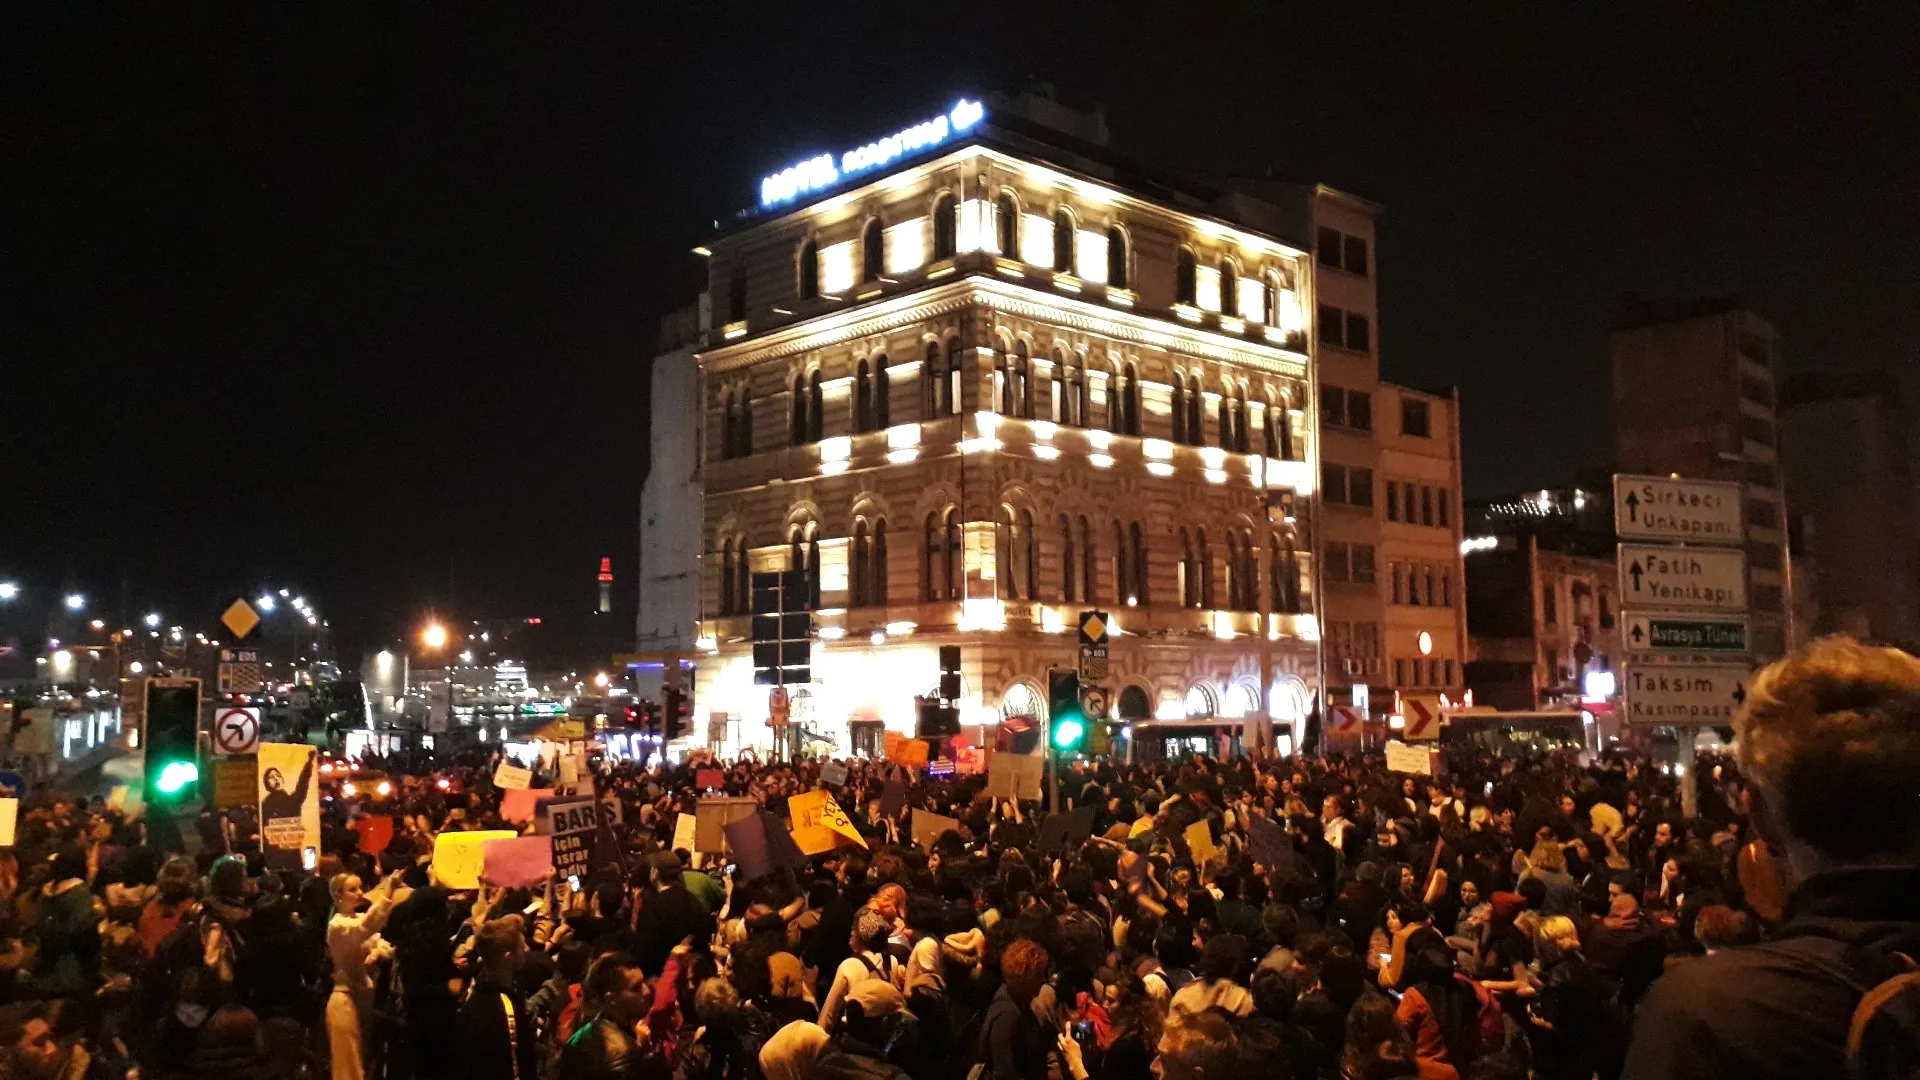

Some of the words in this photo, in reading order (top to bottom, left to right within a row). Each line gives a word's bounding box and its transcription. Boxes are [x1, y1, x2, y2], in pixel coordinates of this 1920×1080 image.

[1643, 484, 1722, 510] Sirkeci
[1646, 555, 1702, 575] Fatih
[1648, 580, 1733, 604] Yenikapı
[1652, 624, 1702, 646] Avrasya
[1633, 672, 1712, 692] Taksim
